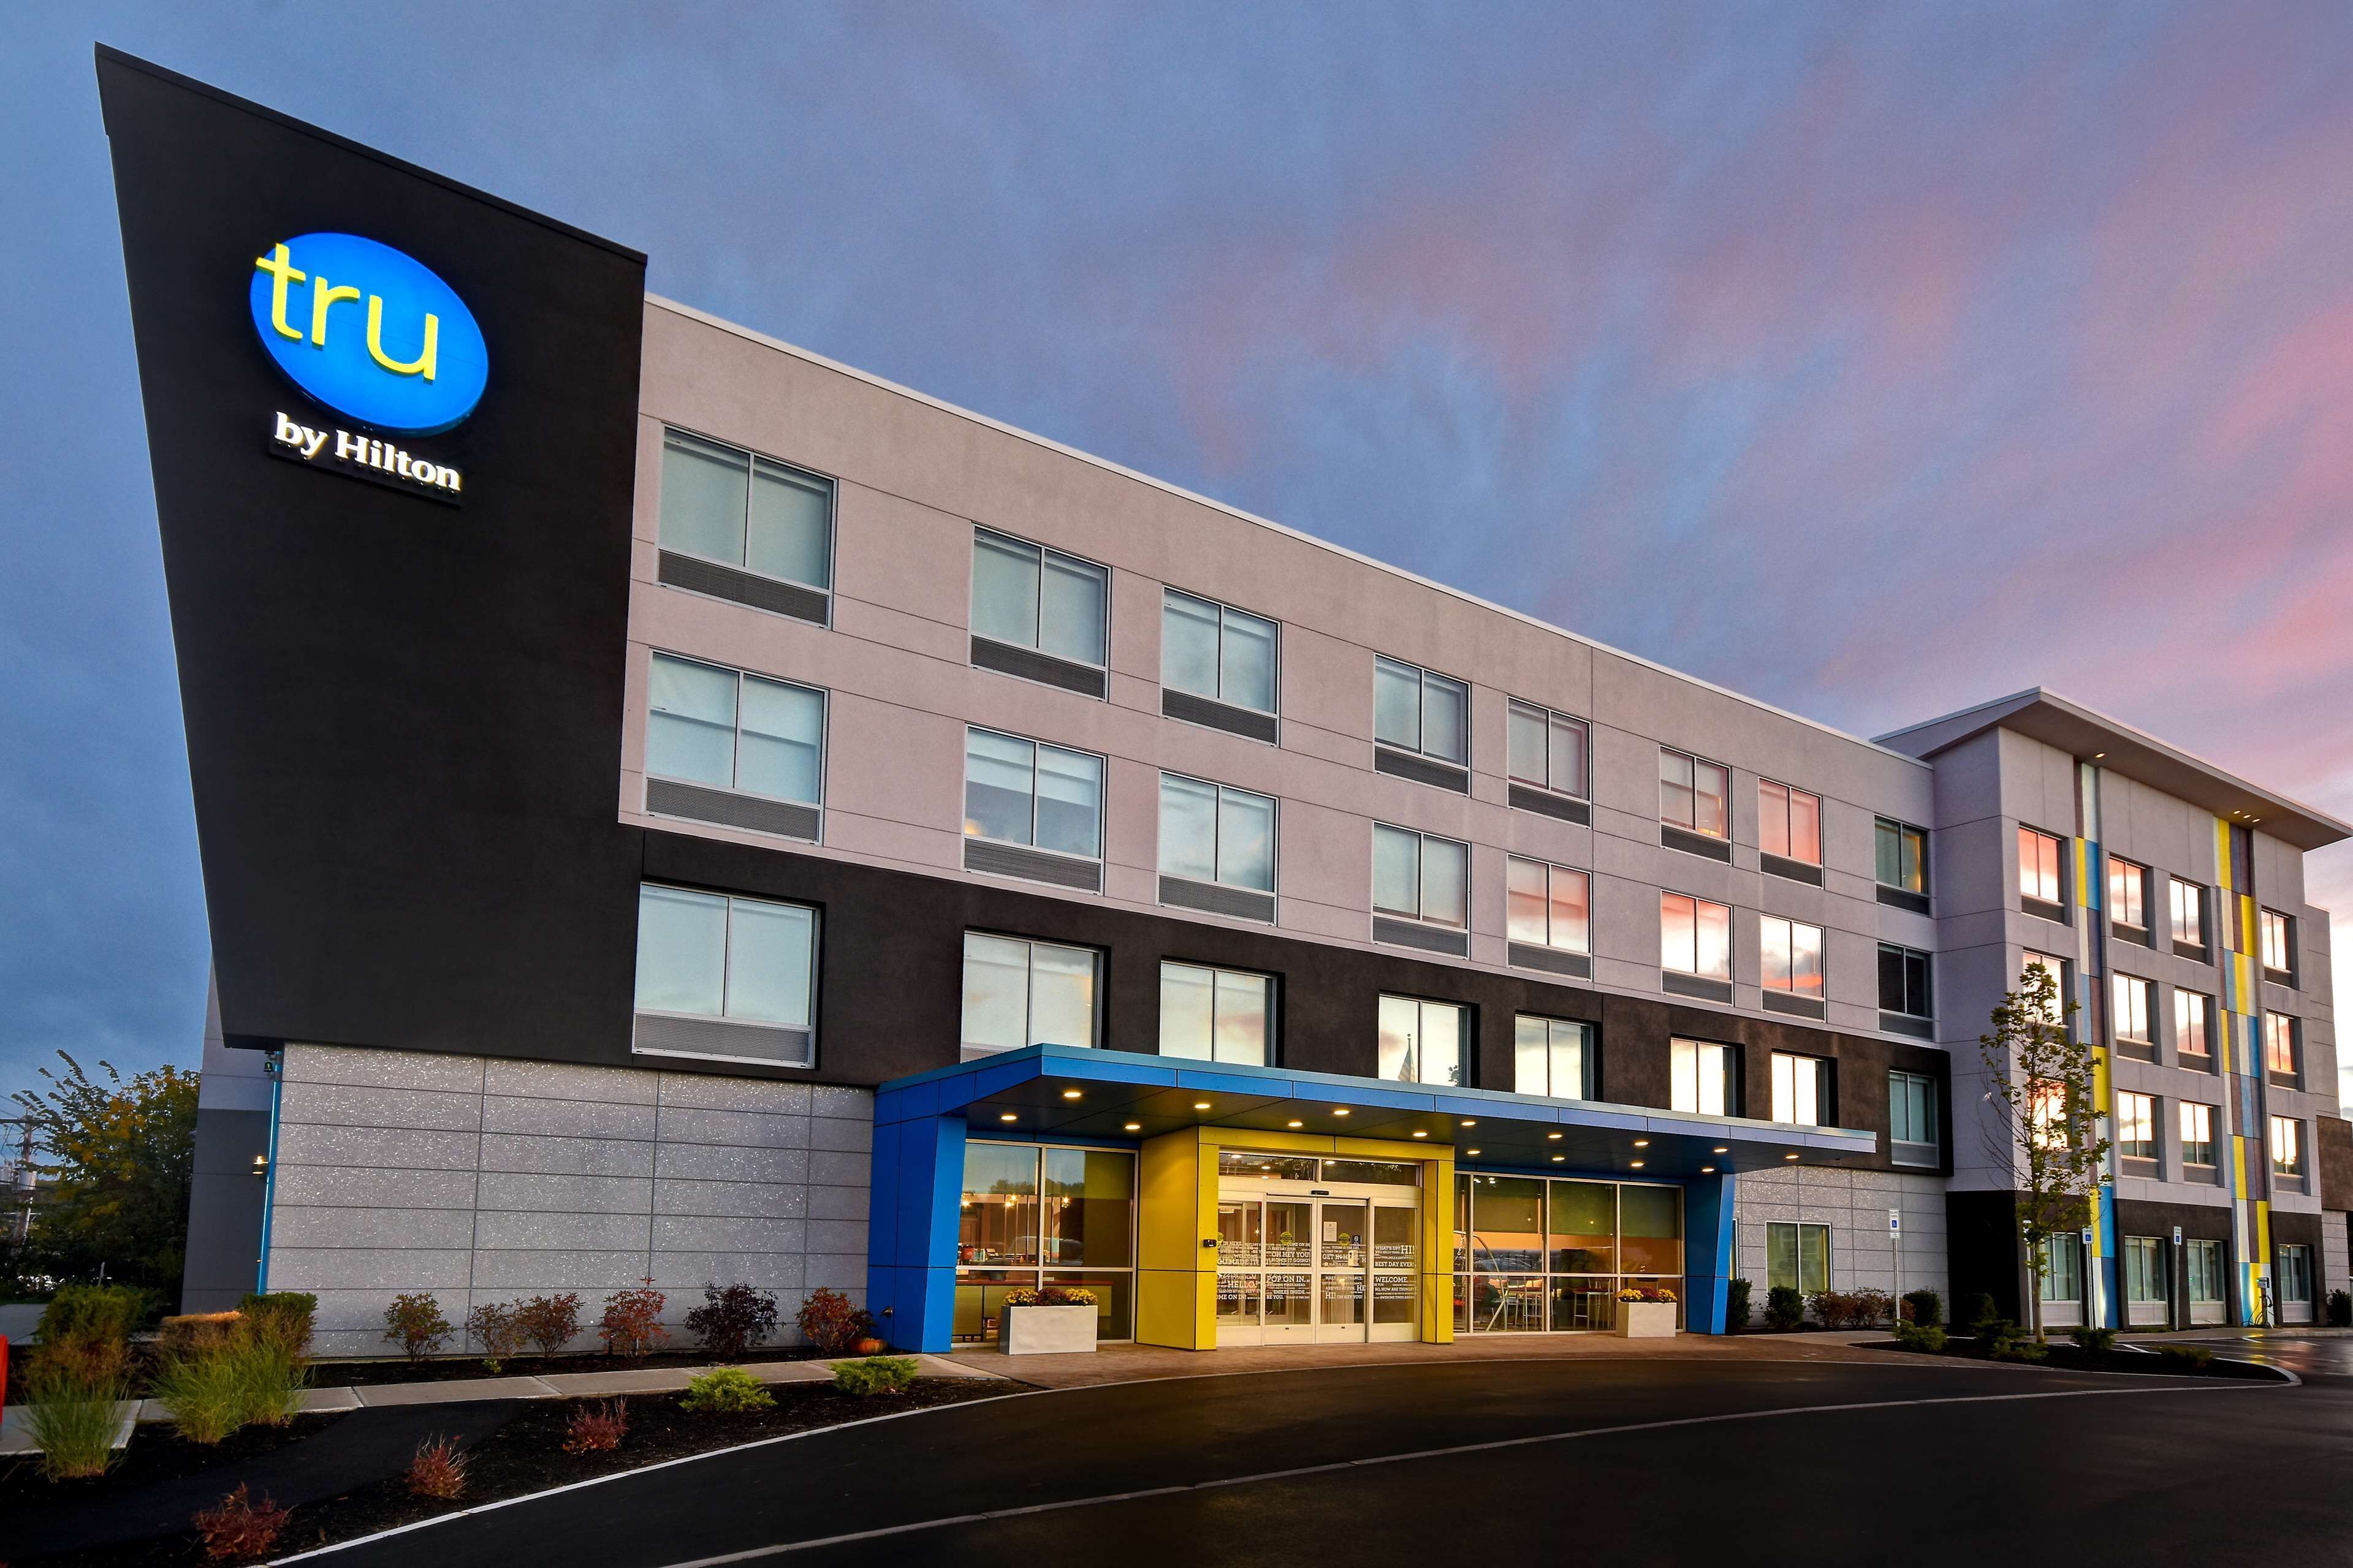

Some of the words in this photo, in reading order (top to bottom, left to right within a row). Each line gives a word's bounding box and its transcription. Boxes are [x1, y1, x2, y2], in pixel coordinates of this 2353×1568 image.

[255, 243, 438, 381] tru
[275, 411, 329, 457] by
[334, 430, 462, 491] Hilton
[1401, 1245, 1415, 1254] HI!
